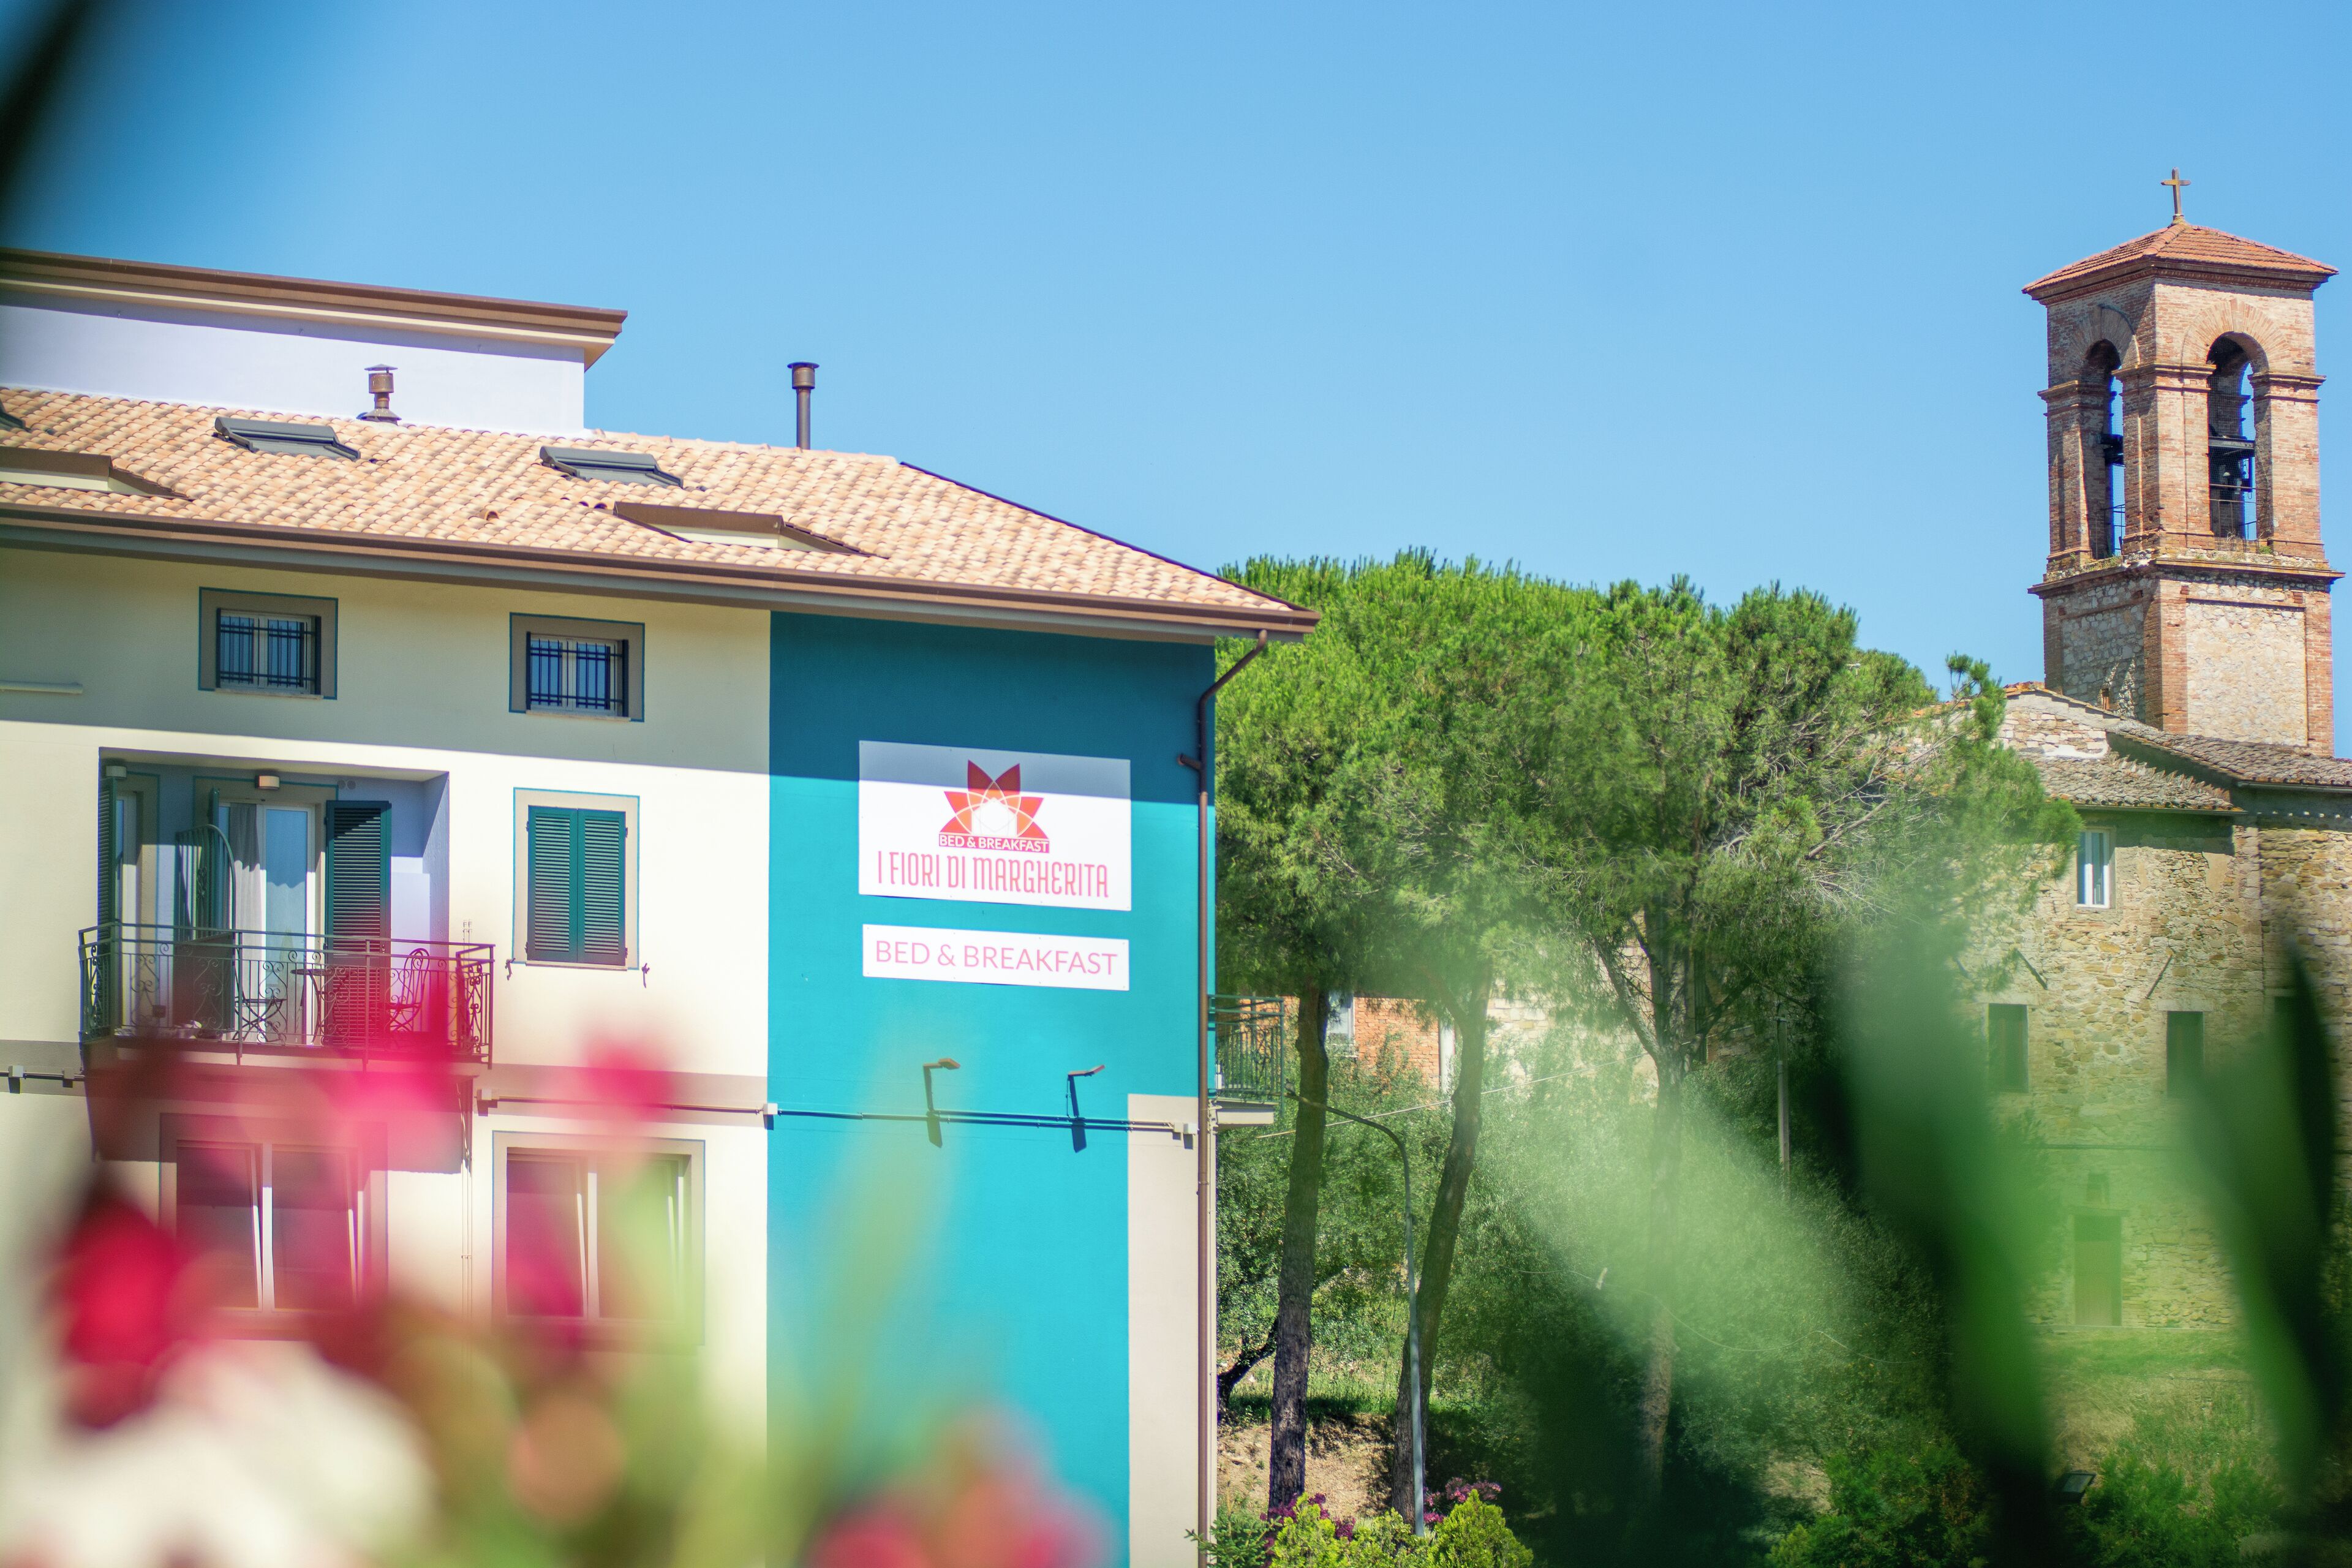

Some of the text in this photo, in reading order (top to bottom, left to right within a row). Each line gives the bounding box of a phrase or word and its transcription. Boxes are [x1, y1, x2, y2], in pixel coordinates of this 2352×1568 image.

[940, 835, 1049, 853] BED & BREAKFAST
[878, 851, 1109, 898] I FIORI DI MARGHERITA
[876, 940, 1118, 975] BED & BREAKFAST
